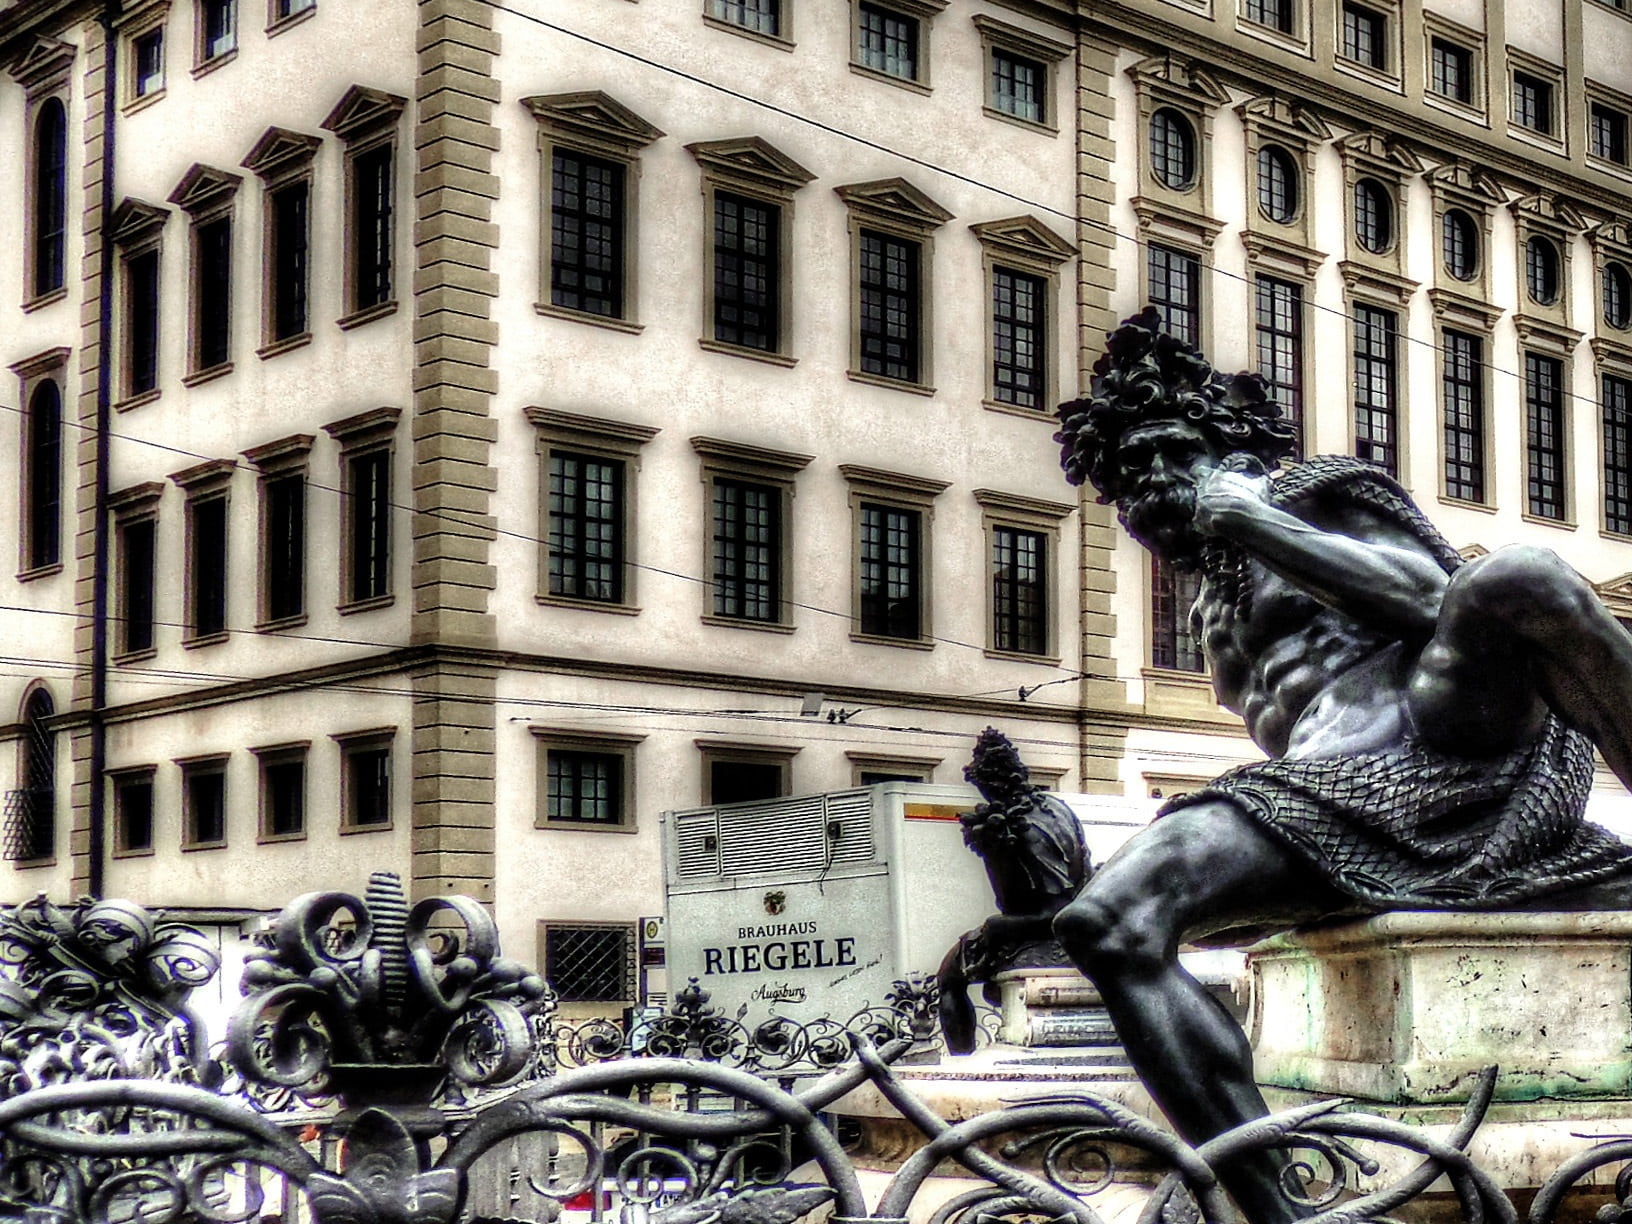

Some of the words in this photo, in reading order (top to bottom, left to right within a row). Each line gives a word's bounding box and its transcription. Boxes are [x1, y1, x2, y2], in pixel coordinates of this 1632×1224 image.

[738, 921, 818, 940] BRAUHAUS
[702, 936, 857, 976] RIEGELE
[750, 982, 808, 1006] Augsburg
